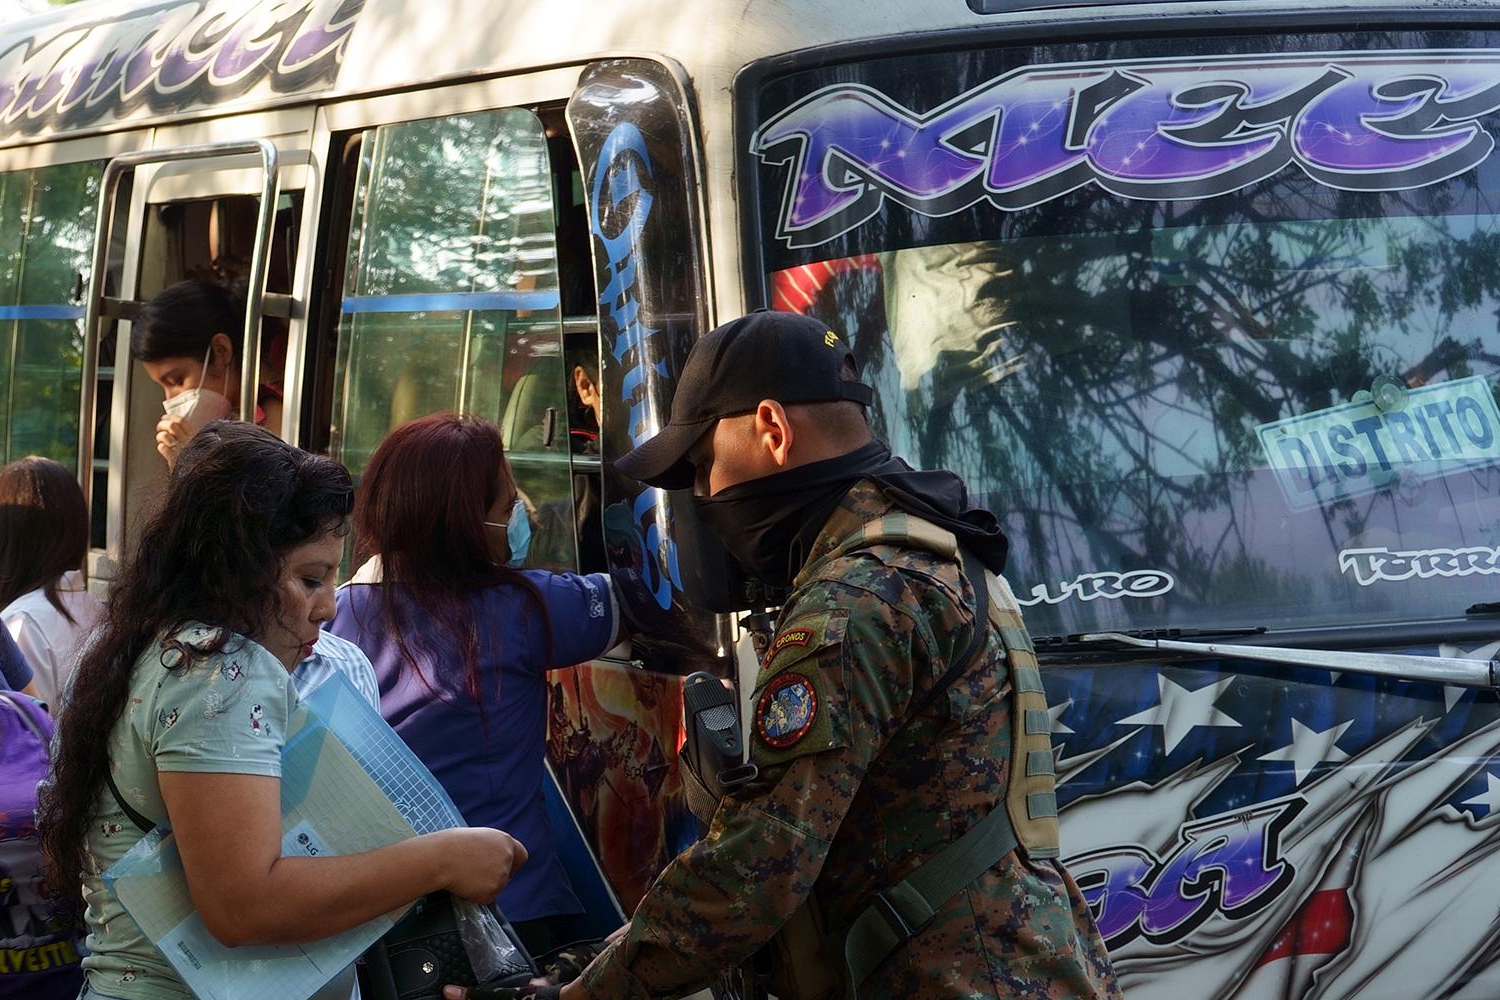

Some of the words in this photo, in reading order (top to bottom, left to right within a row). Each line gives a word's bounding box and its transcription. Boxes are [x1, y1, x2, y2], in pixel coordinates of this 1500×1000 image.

[1276, 395, 1494, 494] DISTRITO
[776, 632, 806, 648] CRONOS
[306, 843, 319, 856] LG
